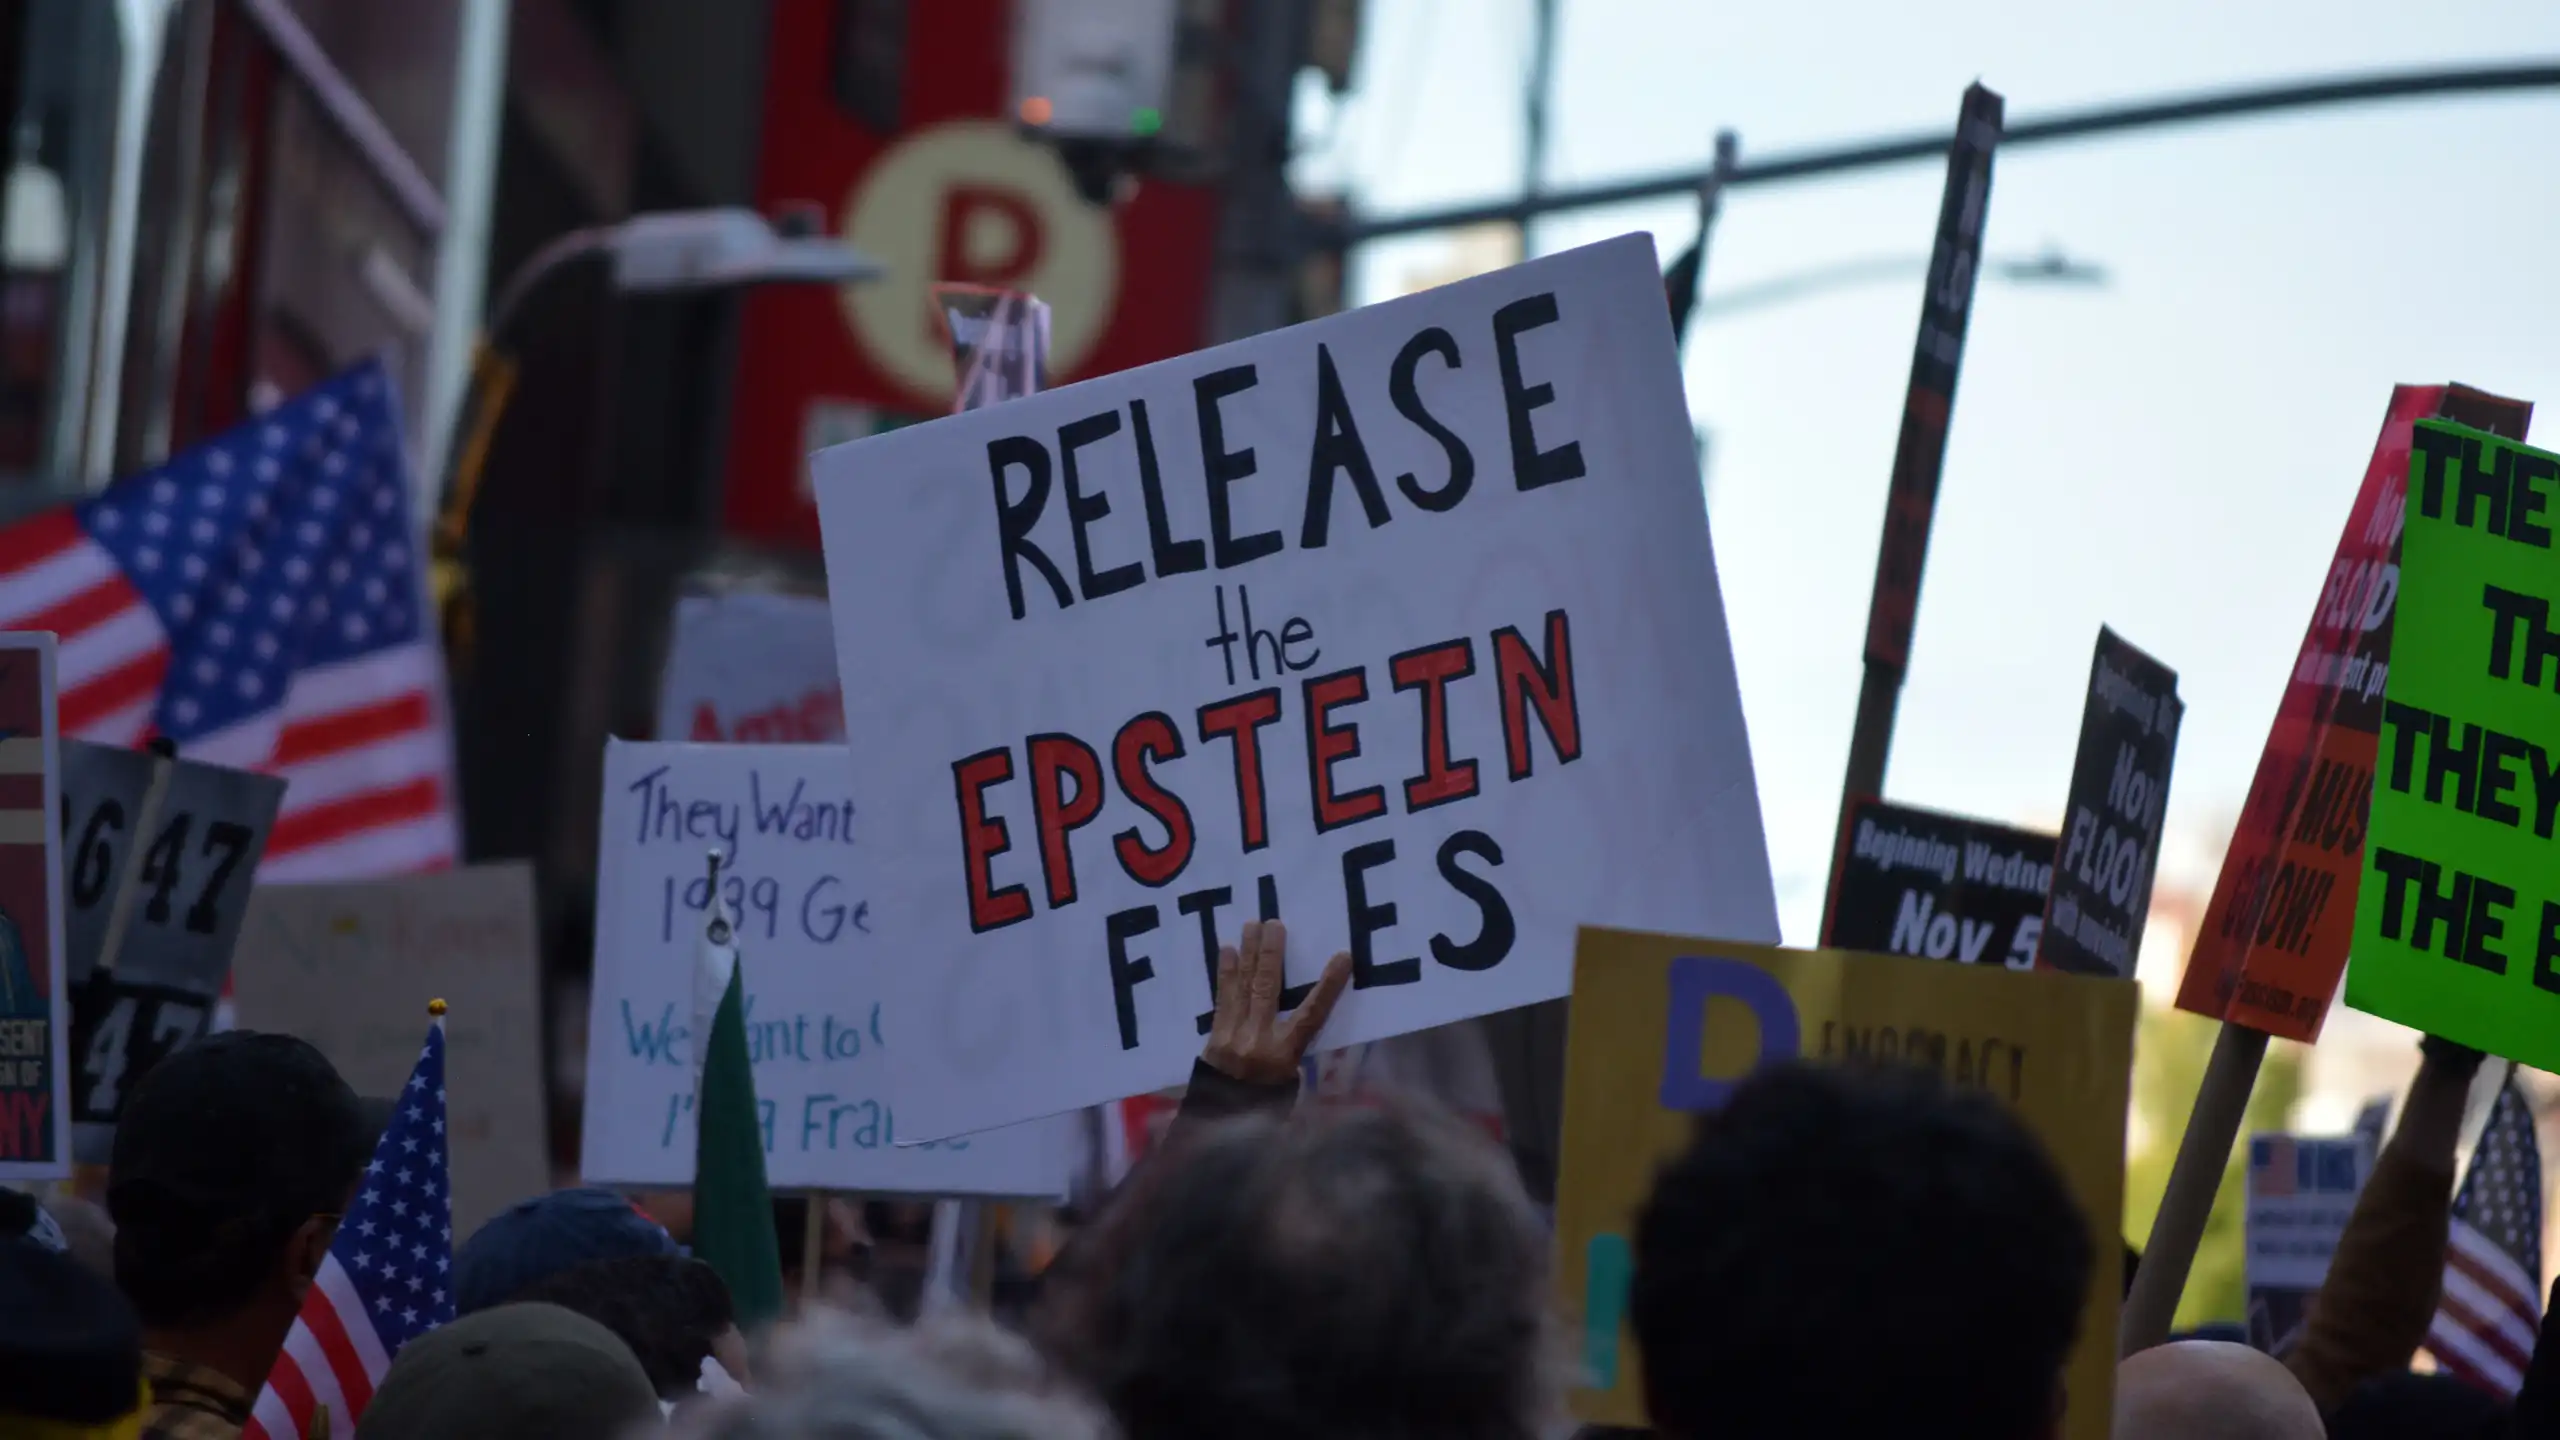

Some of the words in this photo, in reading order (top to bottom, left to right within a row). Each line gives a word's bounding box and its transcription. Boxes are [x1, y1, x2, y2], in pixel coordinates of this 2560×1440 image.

[987, 291, 1586, 620] RELEASE
[2413, 424, 2560, 549] THE
[1206, 584, 1320, 685] the
[628, 764, 740, 870] They
[749, 768, 855, 845] Want
[951, 608, 1582, 933] EPSTEIN
[140, 810, 253, 934] 47
[1855, 816, 1960, 885] Beginning
[2374, 846, 2517, 976] THE
[1106, 830, 1516, 1050] FILES
[1890, 887, 1996, 967] Nov
[2003, 913, 2044, 973] 5
[621, 998, 692, 1067] We
[821, 1013, 860, 1063] to
